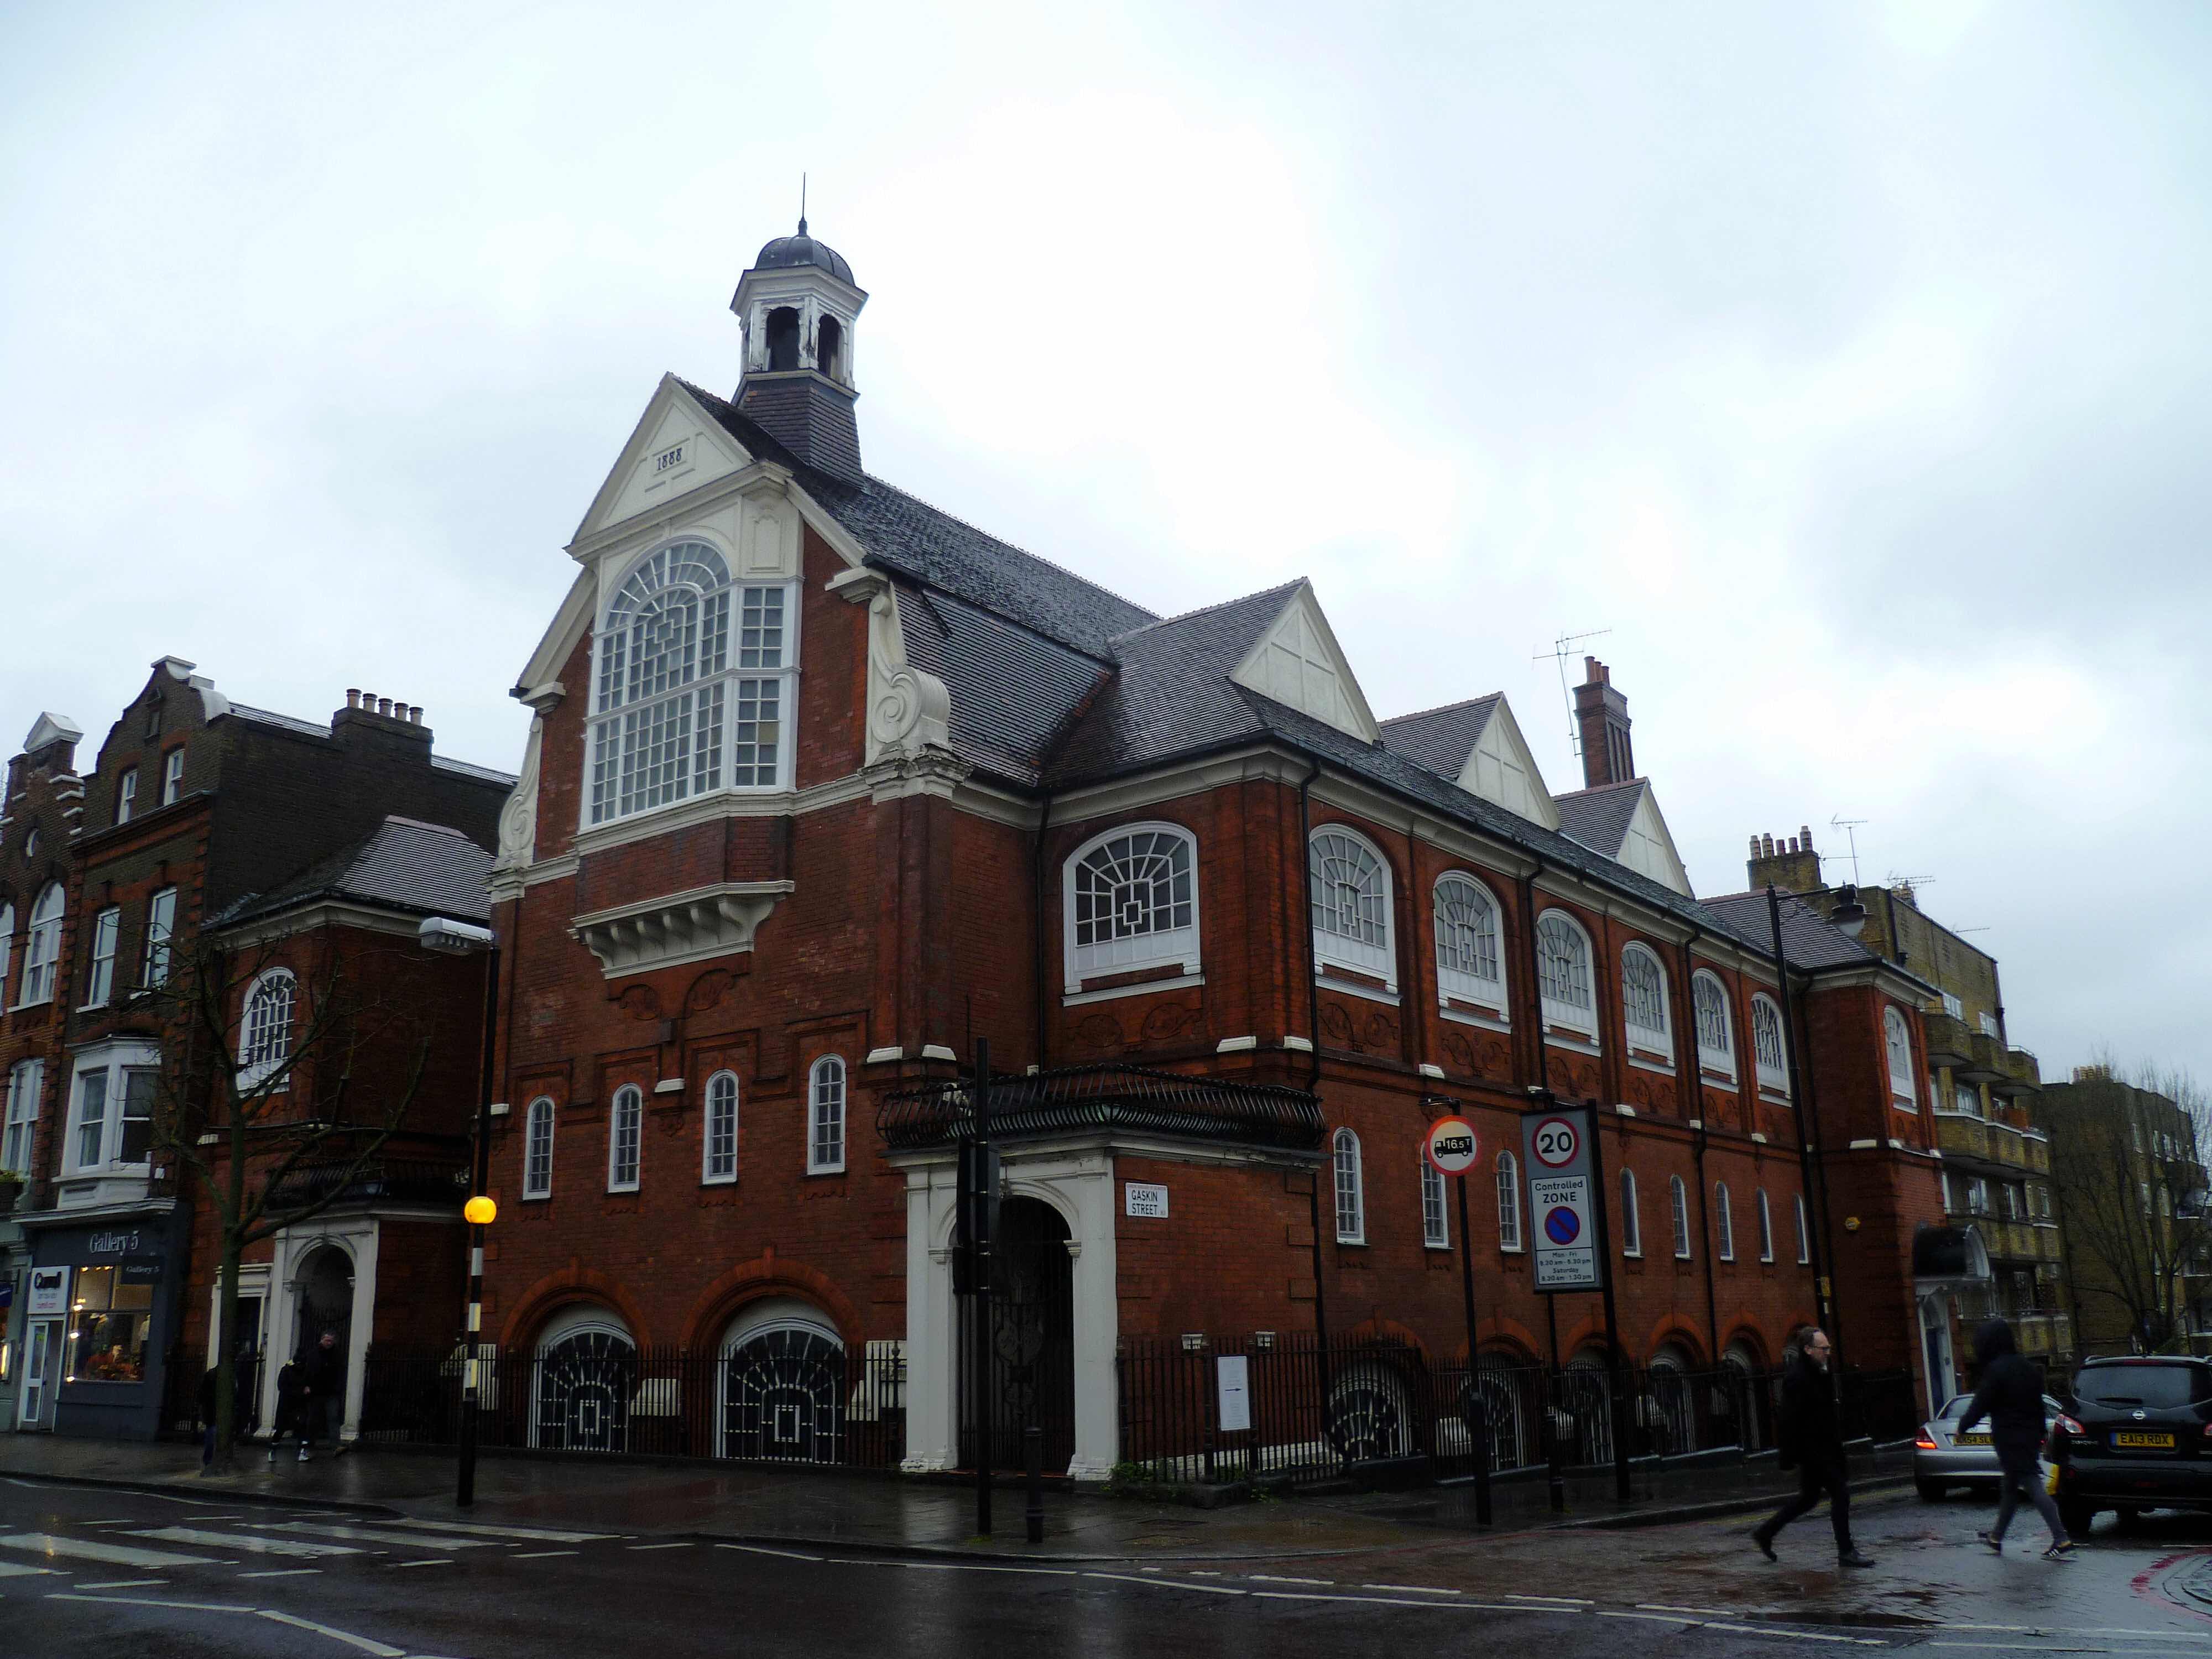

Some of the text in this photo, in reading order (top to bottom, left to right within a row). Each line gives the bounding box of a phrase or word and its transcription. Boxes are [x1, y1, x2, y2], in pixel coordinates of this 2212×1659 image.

[656, 447, 682, 471] 1888
[1540, 1131, 1573, 1154] 20
[1535, 1180, 1583, 1191] Controlled
[1131, 1190, 1157, 1202] GASKIN
[1543, 1192, 1577, 1203] ZONE
[1132, 1203, 1157, 1215] STREET
[90, 1230, 139, 1256] Gallery 5
